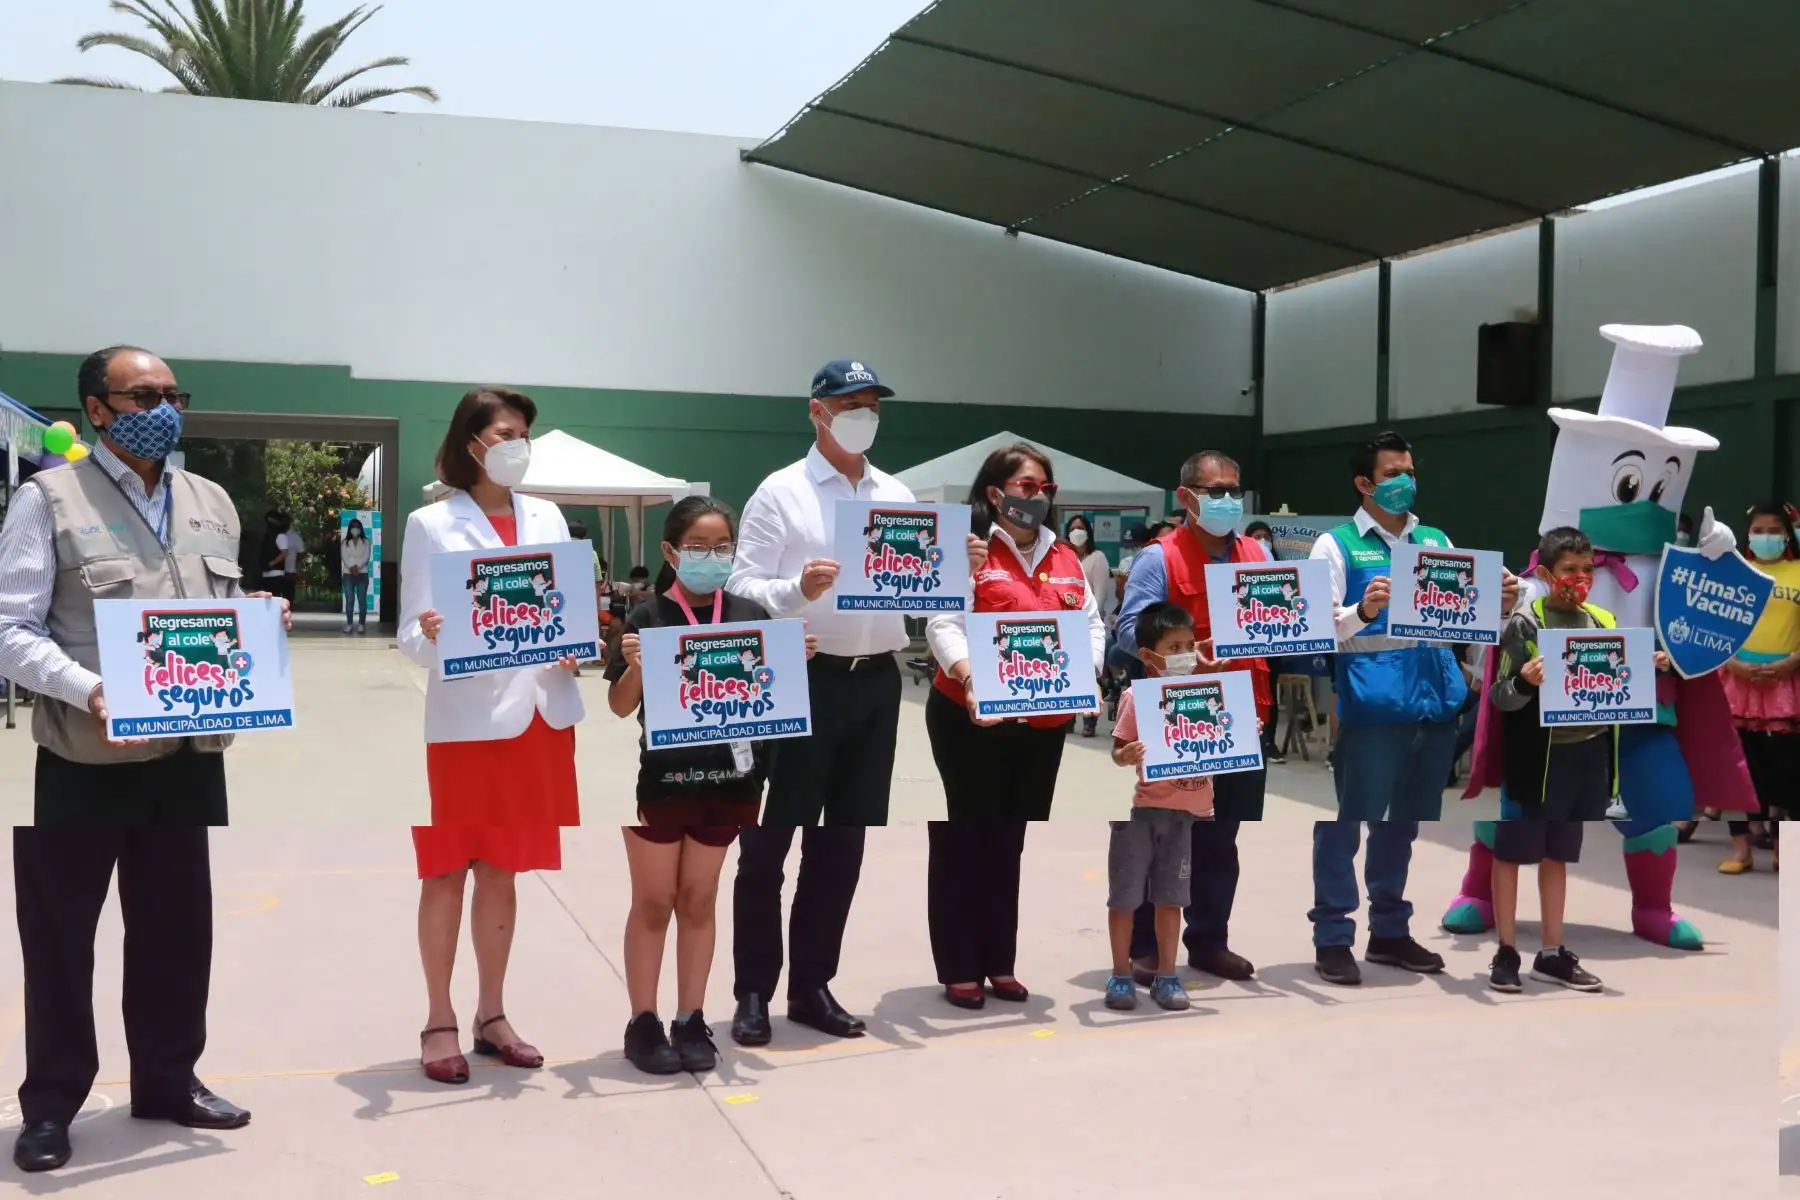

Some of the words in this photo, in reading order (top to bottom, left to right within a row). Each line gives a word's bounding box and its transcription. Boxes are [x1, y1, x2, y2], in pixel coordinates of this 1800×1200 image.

[874, 514, 934, 526] Regresamos
[885, 531, 894, 539] al
[896, 532, 915, 540] cole
[477, 560, 548, 576] Regresamos
[865, 544, 921, 578] felices
[1422, 556, 1471, 568] Regresamos
[492, 579, 503, 591] al
[506, 578, 529, 589] cole
[873, 570, 941, 598] seguros
[1240, 573, 1295, 583] Regresamos
[1671, 566, 1756, 606] #LimaSe
[1262, 585, 1279, 594] cole
[1414, 583, 1460, 610] felices
[854, 600, 922, 608] MUNICIPALIDAD
[940, 601, 960, 609] LIMA
[1237, 599, 1289, 628] felices
[1686, 588, 1754, 625] Vacuna
[149, 615, 233, 630] Regresamos
[472, 596, 540, 636] felices
[1420, 607, 1476, 627] seguros
[484, 616, 565, 652] seguros
[1000, 624, 1055, 635] Regresamos
[1245, 617, 1309, 643] seguros
[1405, 627, 1460, 638] MUNICIPALIDAD
[168, 634, 180, 646] al
[183, 634, 210, 646] cole
[686, 637, 758, 652] Regresamos
[1023, 638, 1041, 646] cole
[1231, 644, 1294, 655] MUNICIPALIDAD
[1310, 642, 1330, 650] LIMA
[1570, 641, 1621, 651] Regresamos
[1694, 631, 1732, 654] LIMA
[464, 651, 546, 670] MUNICIPALIDAD
[550, 649, 563, 659] DE
[702, 655, 711, 665] al
[714, 654, 737, 664] cole
[999, 652, 1051, 683] felices
[144, 652, 224, 695] felices
[1565, 666, 1613, 695] felices
[680, 671, 749, 710] felices
[1008, 672, 1070, 699] seguros
[1166, 686, 1219, 699] Regresamos
[158, 677, 254, 716] seguros
[995, 701, 1057, 711] MUNICIPALIDAD
[1072, 699, 1091, 707] LIMA
[1178, 701, 1186, 710] al
[1188, 701, 1205, 709] cole
[1572, 686, 1630, 710] seguros
[691, 692, 774, 726] seguros
[1558, 712, 1616, 721] MUNICIPALIDAD
[136, 717, 232, 733] MUNICIPALIDAD
[236, 716, 252, 726] DE
[256, 714, 286, 726] LIMA
[672, 726, 754, 742] MUNICIPALIDAD
[758, 725, 772, 734] DE
[776, 722, 801, 732] LIMA
[1165, 716, 1216, 747] felices
[1174, 732, 1234, 761] seguros
[1161, 761, 1221, 775] MUNICIPALIDAD
[1224, 760, 1234, 768] DE
[1236, 758, 1256, 767] LIMA
[662, 768, 704, 785] SQUID
